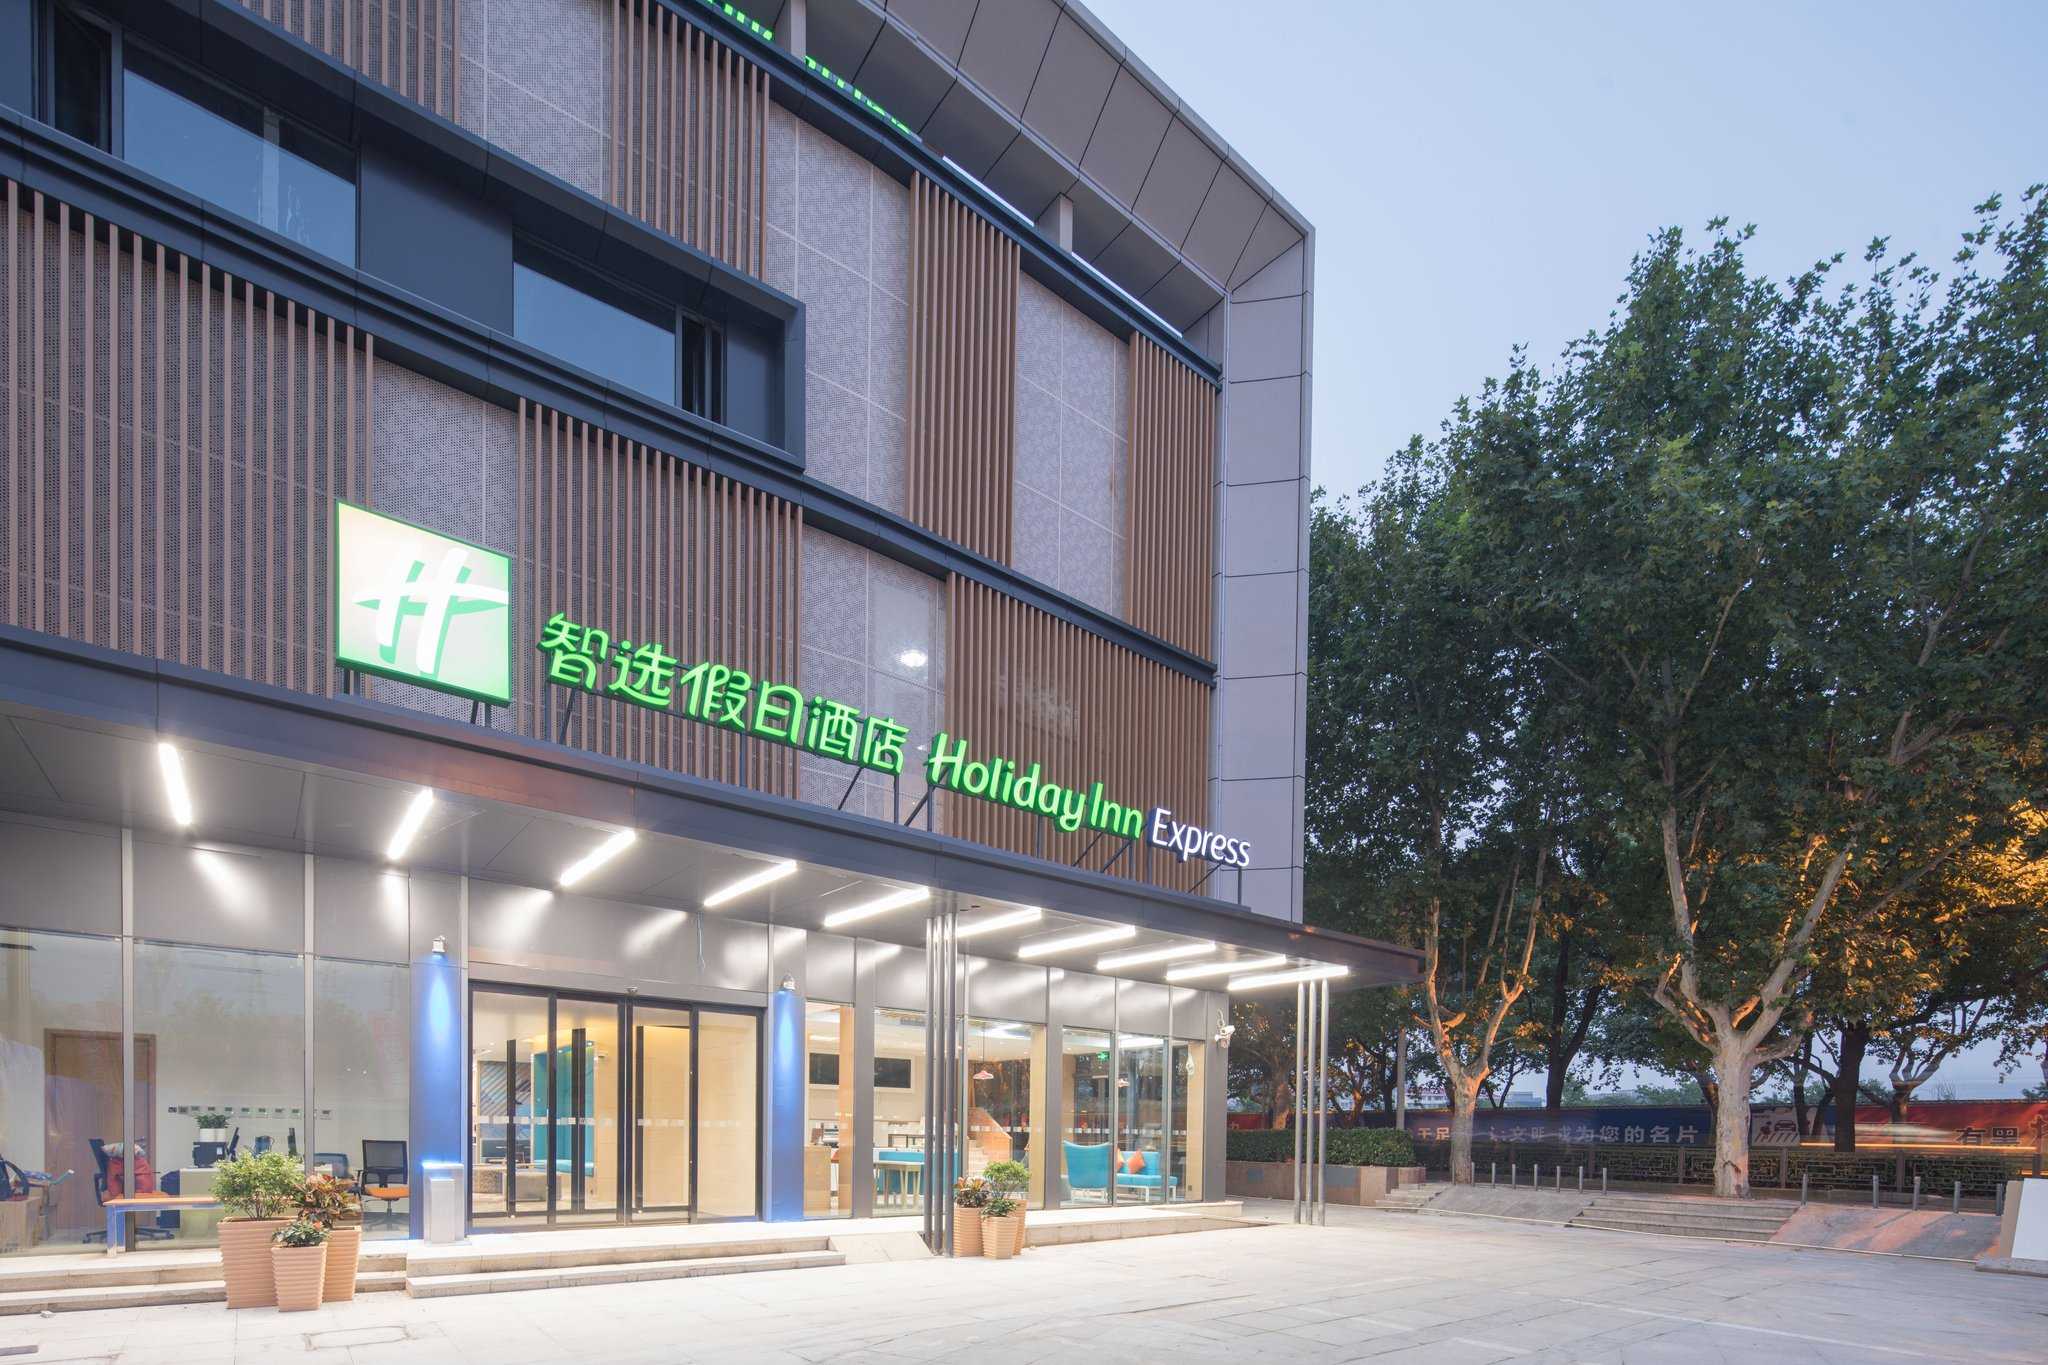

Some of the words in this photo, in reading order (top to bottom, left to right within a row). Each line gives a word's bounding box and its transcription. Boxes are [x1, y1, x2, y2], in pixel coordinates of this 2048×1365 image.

[537, 611, 911, 775] 智选假日酒店
[926, 731, 1088, 833] Holiday
[1087, 781, 1144, 841] Inn
[1150, 806, 1251, 867] Express
